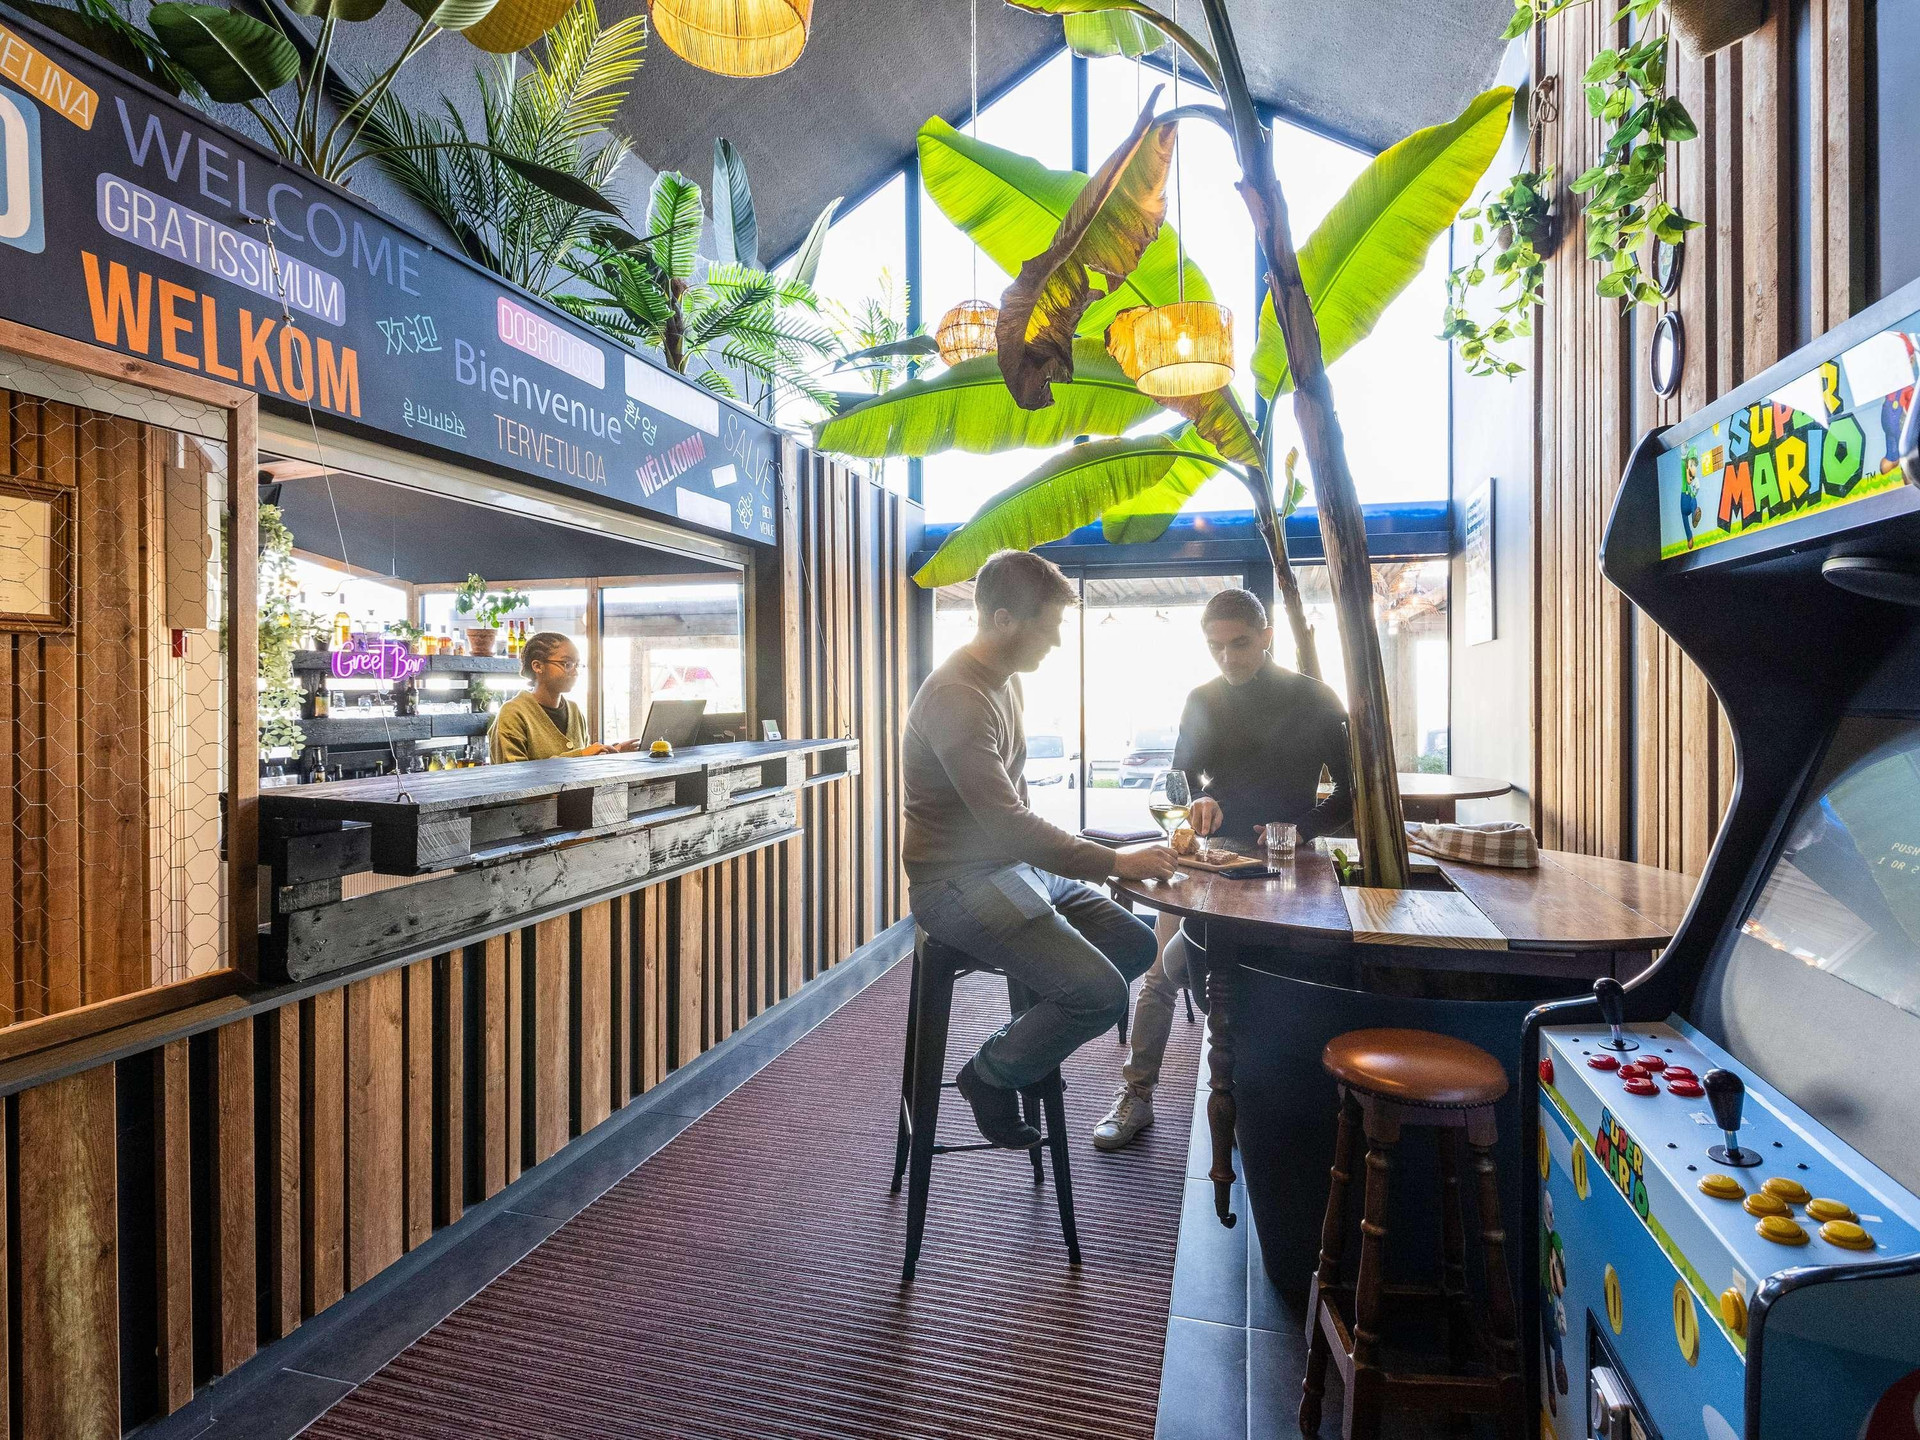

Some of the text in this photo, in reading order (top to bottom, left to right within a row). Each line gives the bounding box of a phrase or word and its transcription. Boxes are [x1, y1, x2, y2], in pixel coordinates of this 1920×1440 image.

[0, 32, 90, 126] ELINA
[115, 97, 421, 298] WELCOME
[104, 180, 340, 322] GRATISSIMUM
[81, 250, 362, 418] WELKOM
[376, 314, 442, 355] 欢迎
[454, 338, 622, 445] Bienvenue
[493, 413, 607, 487] TERVETULOA
[635, 431, 707, 498] WËLLKOMM
[724, 414, 775, 500] SALVE
[1718, 415, 1865, 532] MARIO
[336, 637, 424, 680] Greet Bar
[1890, 860, 1906, 871] OR
[1891, 842, 1920, 856] PUSH
[1595, 1126, 1650, 1221] MARIO
[1601, 1106, 1643, 1179] SUPER
